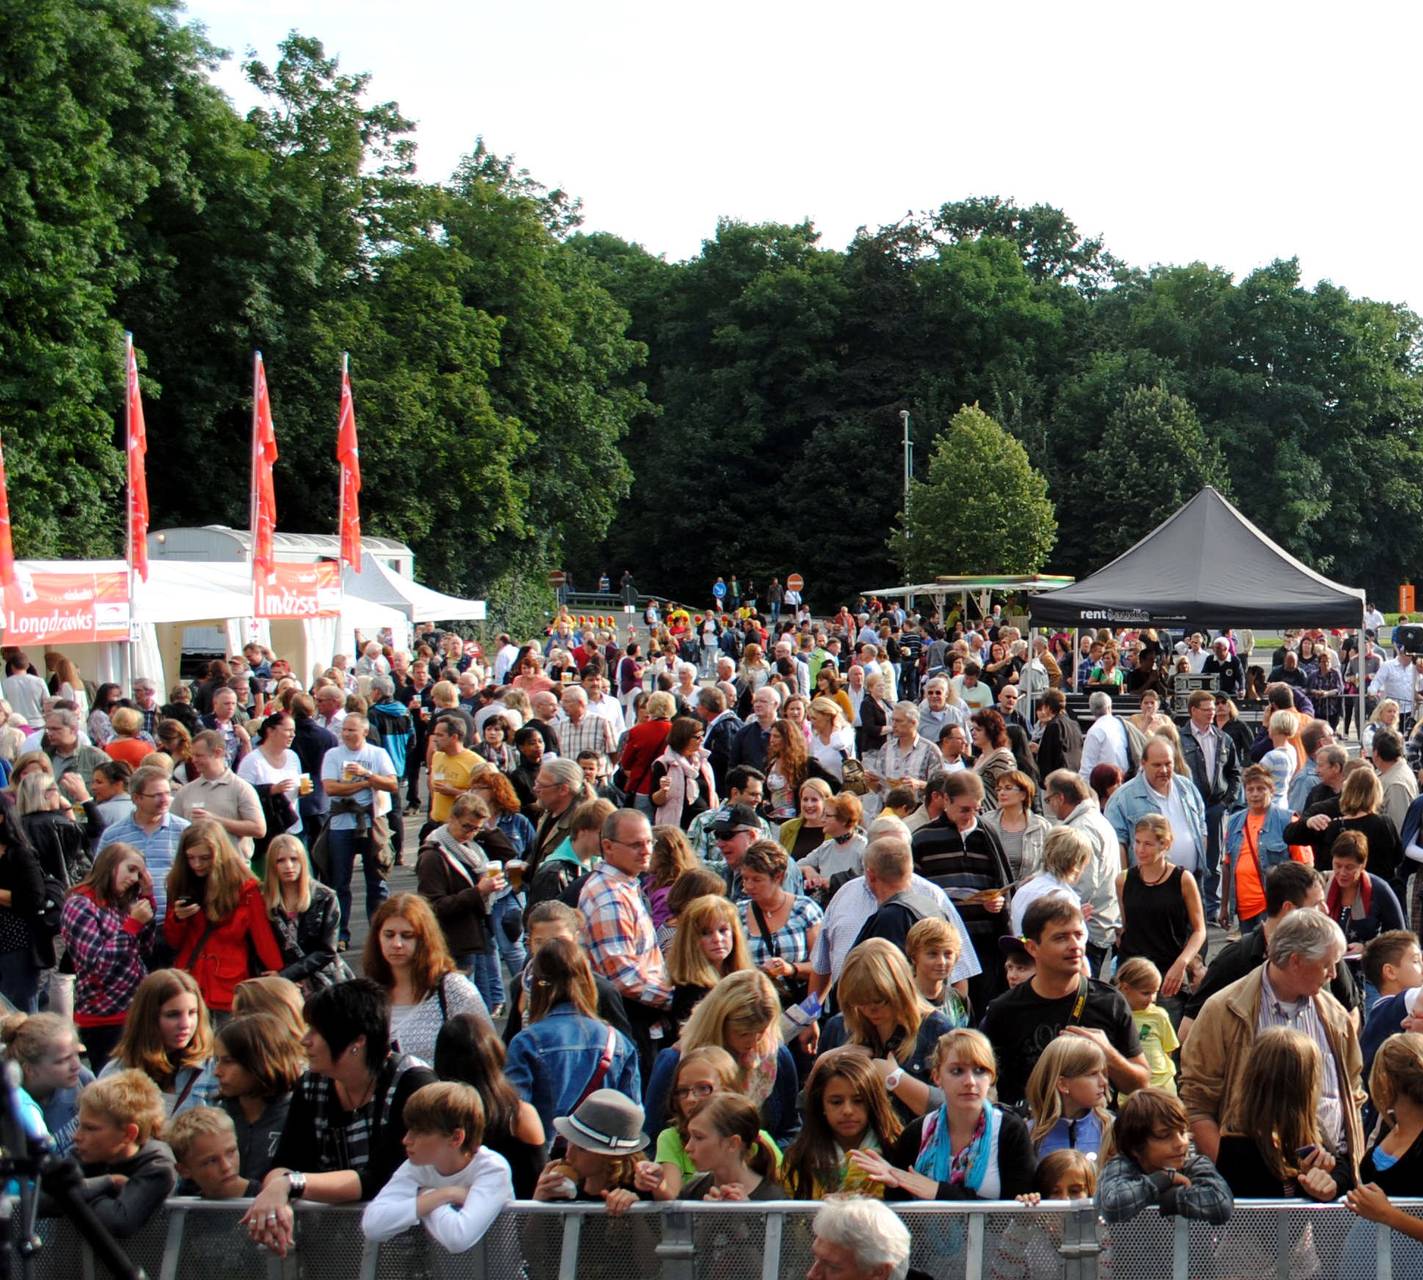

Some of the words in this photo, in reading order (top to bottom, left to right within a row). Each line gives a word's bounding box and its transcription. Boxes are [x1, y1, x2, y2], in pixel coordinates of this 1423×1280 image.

[259, 586, 318, 615] Imbiss
[1080, 610, 1107, 620] rent
[10, 609, 94, 639] Longdrinks
